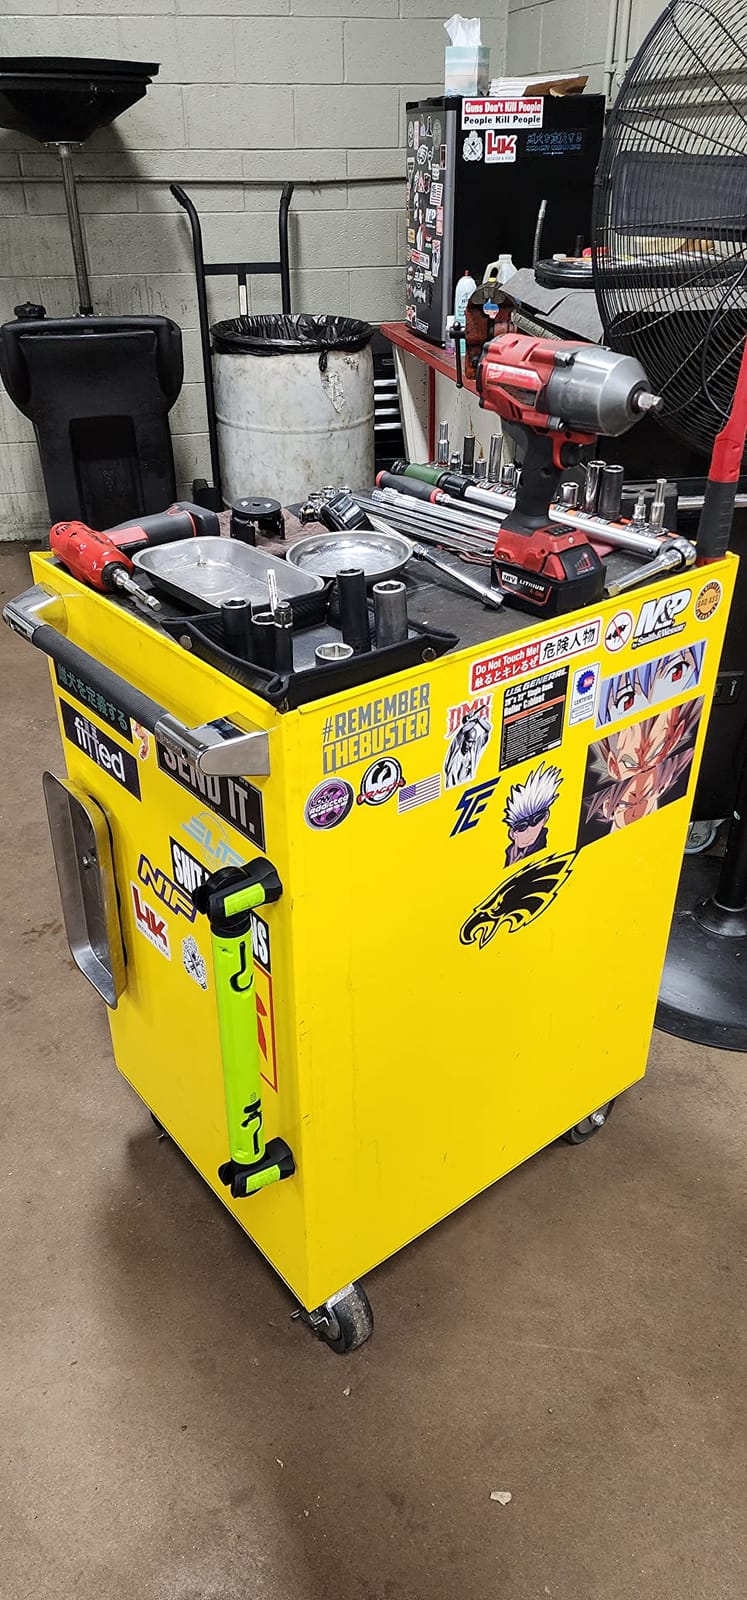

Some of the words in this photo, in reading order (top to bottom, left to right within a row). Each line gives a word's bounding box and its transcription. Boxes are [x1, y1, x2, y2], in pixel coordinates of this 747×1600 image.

[464, 116, 492, 126] People
[495, 115, 510, 124] Kill
[513, 115, 541, 125] People
[465, 102, 483, 113] Guns
[484, 101, 503, 112] Don't
[505, 101, 517, 112] Kill
[518, 100, 541, 114] People
[519, 579, 545, 592] LITHIUM
[633, 588, 692, 638] M&P
[475, 664, 486, 676] Do
[488, 659, 501, 671] Not
[503, 651, 525, 666] Touch
[526, 644, 539, 657] Me!
[542, 628, 596, 660] 危険人物
[475, 655, 539, 689] 触るとキレるぜ
[322, 683, 430, 743] #REMEMBER
[324, 708, 430, 774] THEBUSTER
[227, 778, 255, 835] IT.
